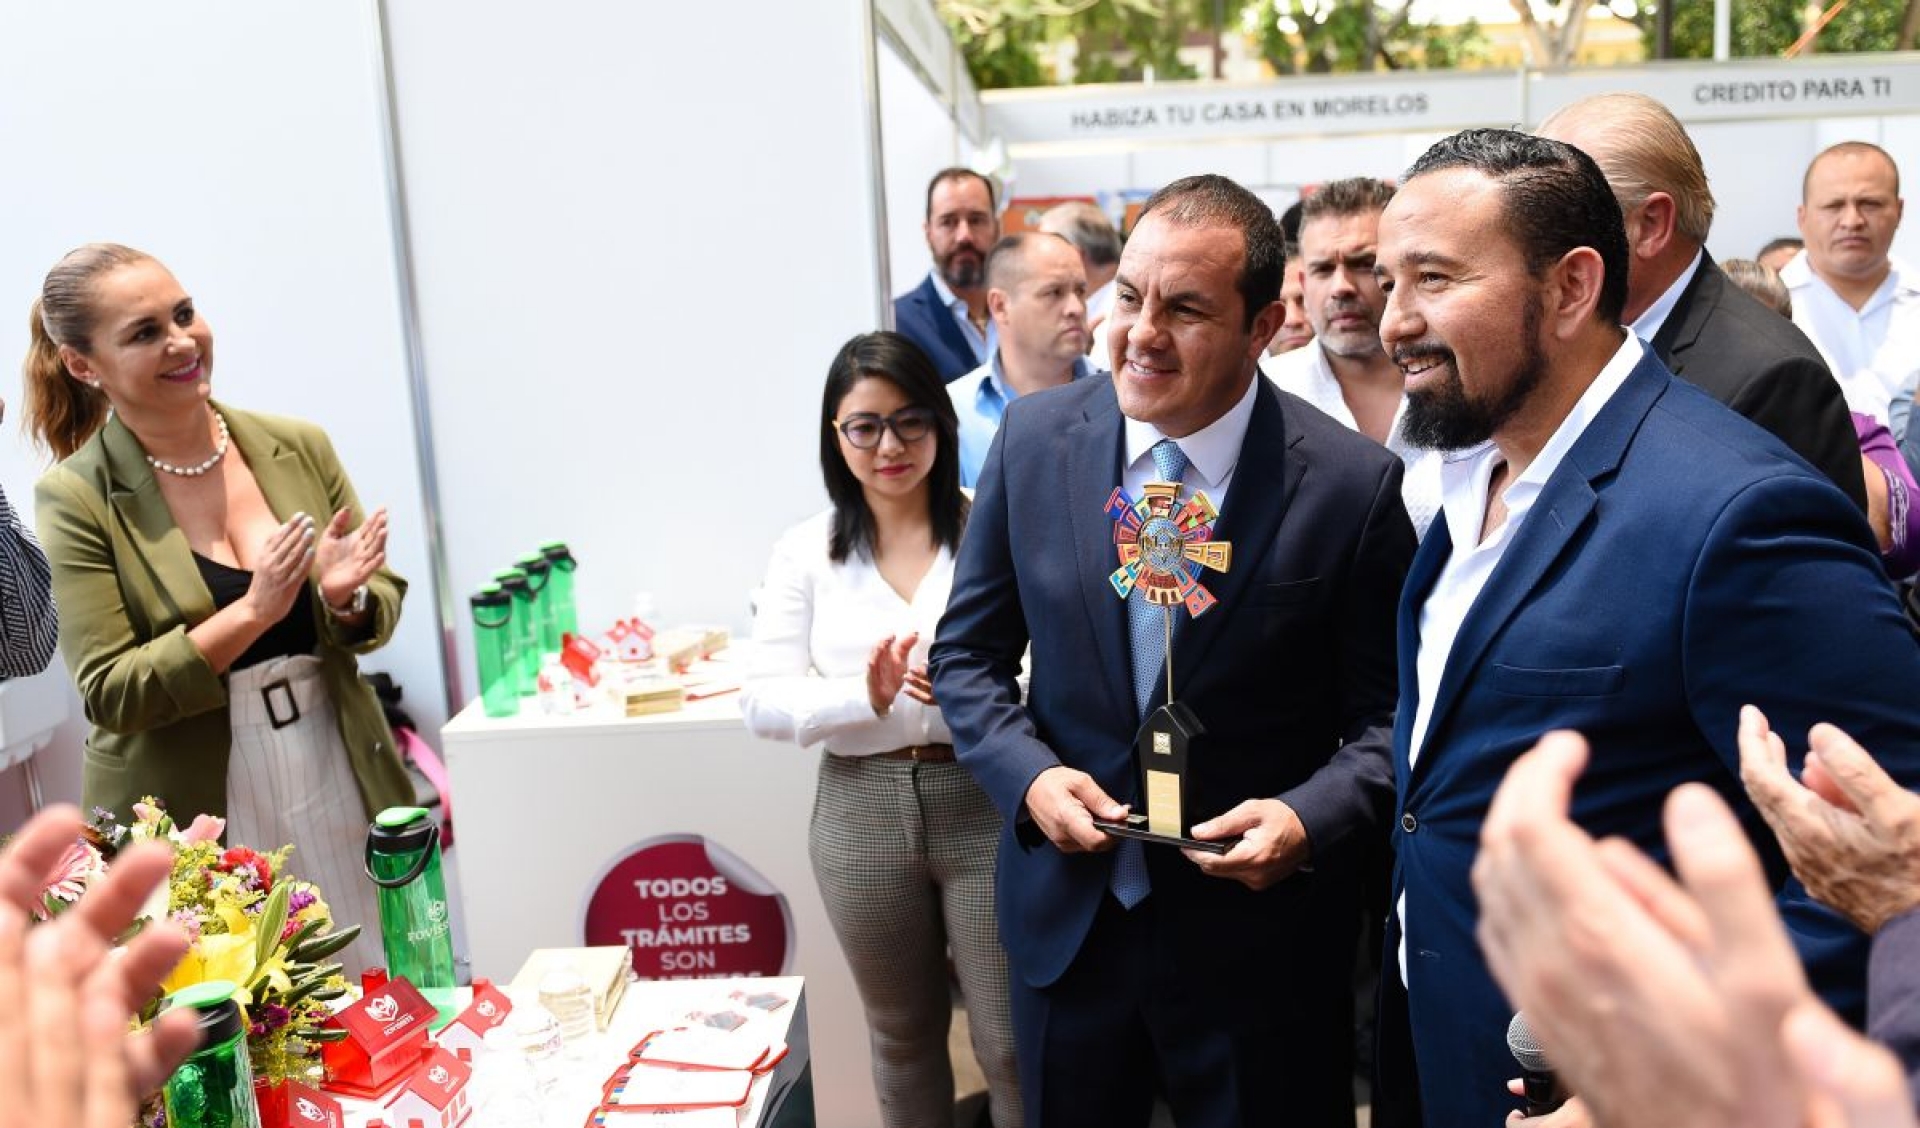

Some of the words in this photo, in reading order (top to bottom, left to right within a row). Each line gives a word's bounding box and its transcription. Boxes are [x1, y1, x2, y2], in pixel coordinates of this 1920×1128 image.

[1694, 80, 1796, 104] CREDITO
[1804, 77, 1865, 99] PARA
[1872, 76, 1892, 97] TI
[1071, 105, 1158, 129] HABIZA
[1167, 104, 1194, 125] TU
[1202, 102, 1267, 123] CASA
[1275, 99, 1304, 120] EN
[1313, 93, 1430, 117] MORELOS
[634, 876, 727, 899] TODOS
[658, 901, 710, 922] LOS
[620, 923, 751, 947] TRÁMITES
[660, 951, 716, 970] SON
